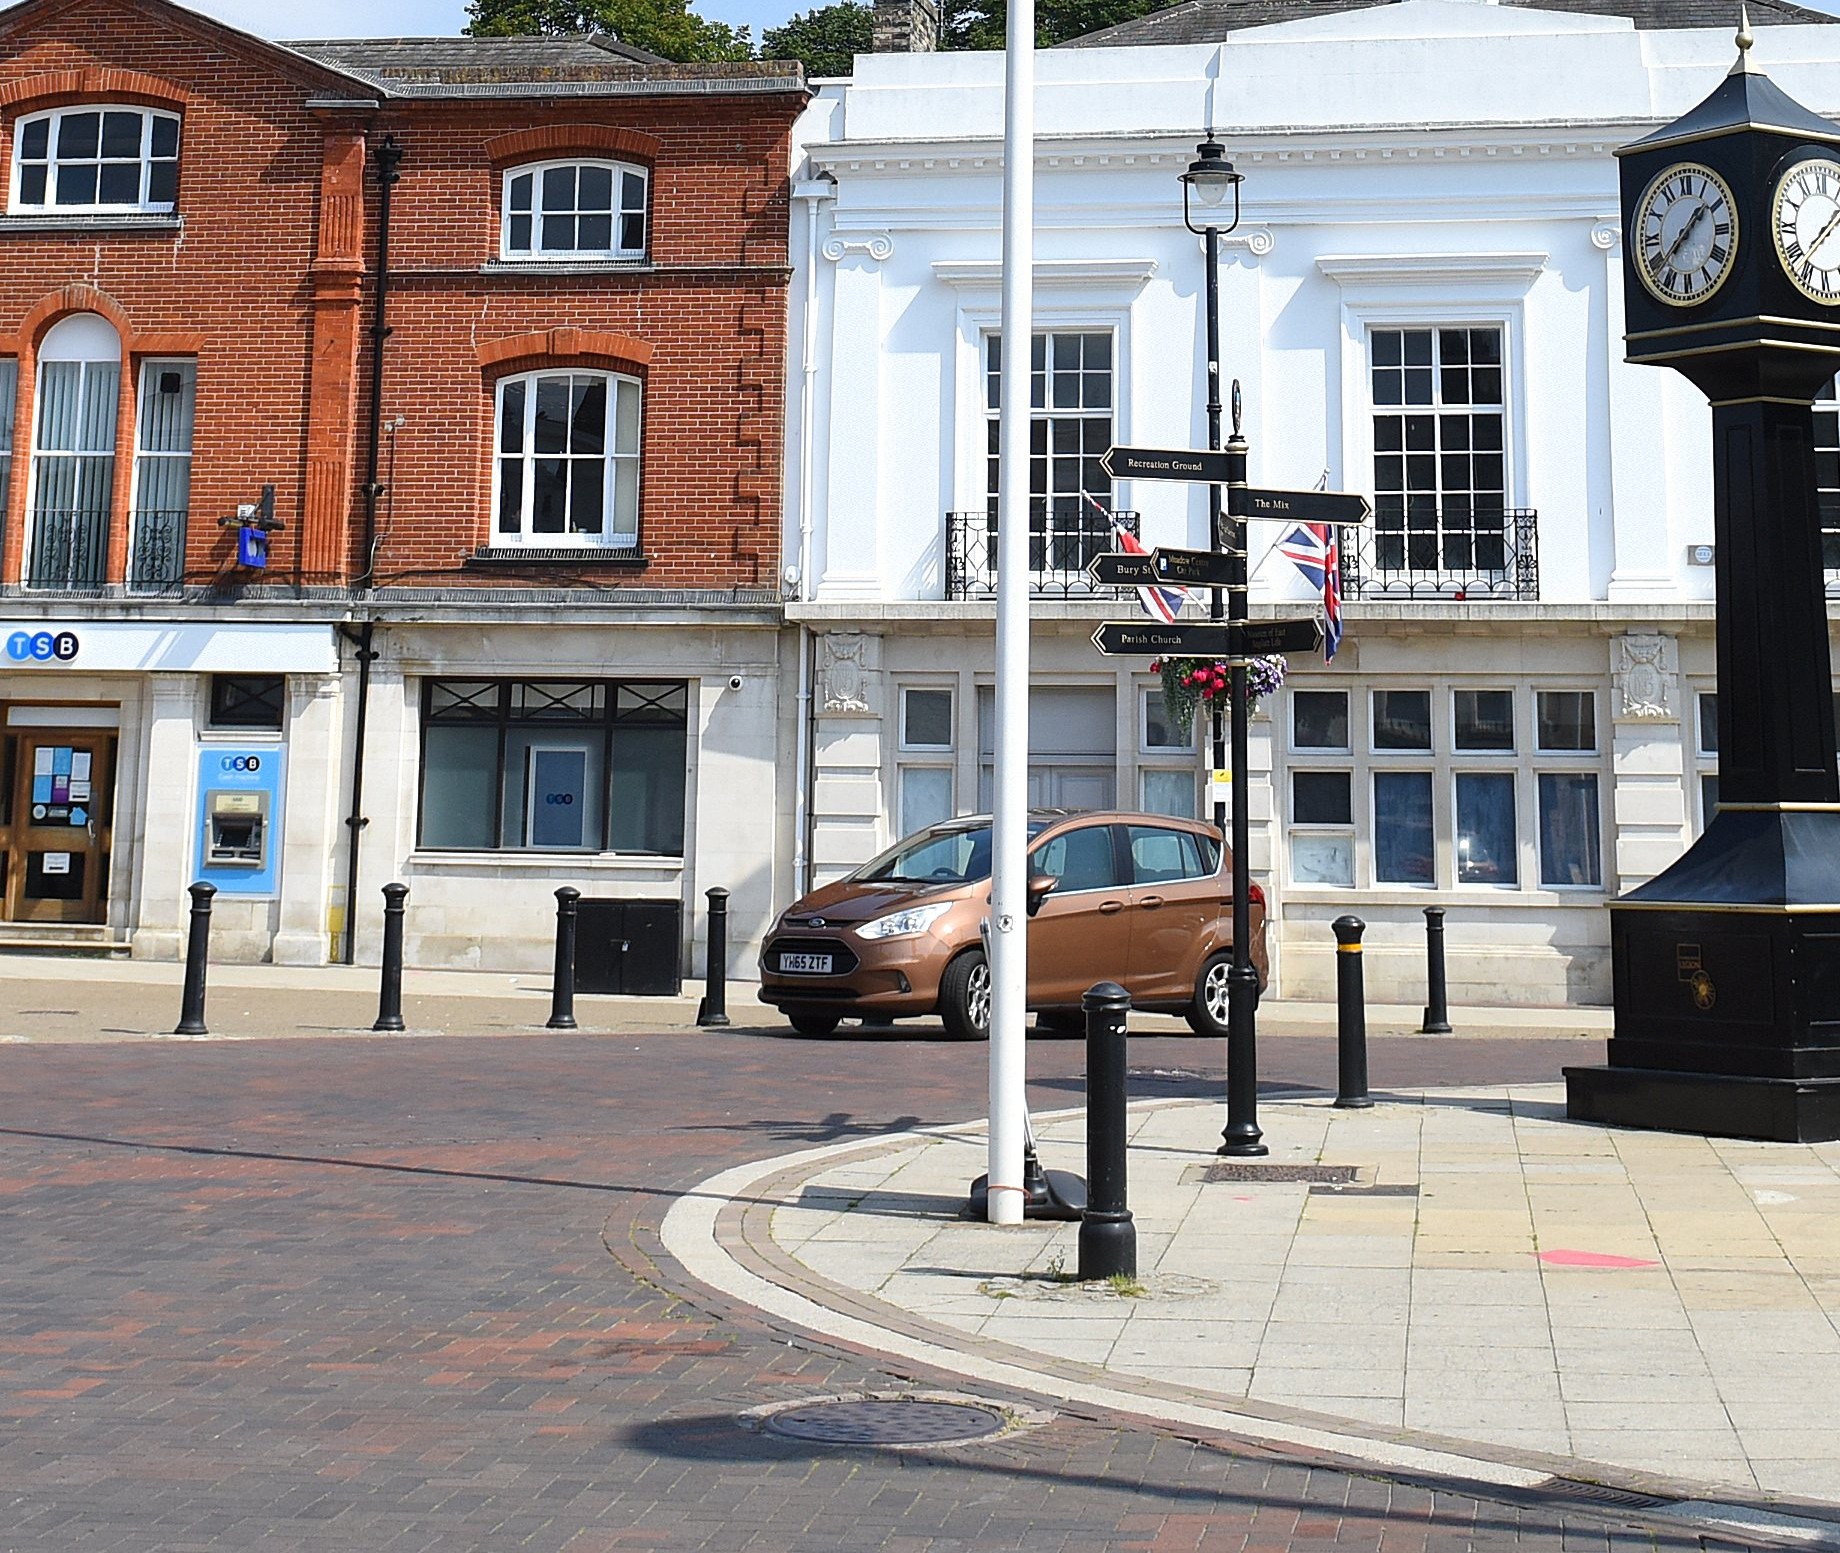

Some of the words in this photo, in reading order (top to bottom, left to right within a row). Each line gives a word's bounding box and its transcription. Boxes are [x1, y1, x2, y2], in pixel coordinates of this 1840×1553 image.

[1128, 458, 1169, 469] Recreation
[1172, 461, 1202, 471] Ground
[1255, 499, 1270, 508] The
[1273, 500, 1289, 509] Mix
[1117, 565, 1139, 576] Bury
[1121, 634, 1148, 644] Parish
[1151, 634, 1182, 644] Church
[10, 635, 77, 658] TSB
[222, 757, 259, 770] TSB
[808, 956, 829, 970] ZTF
